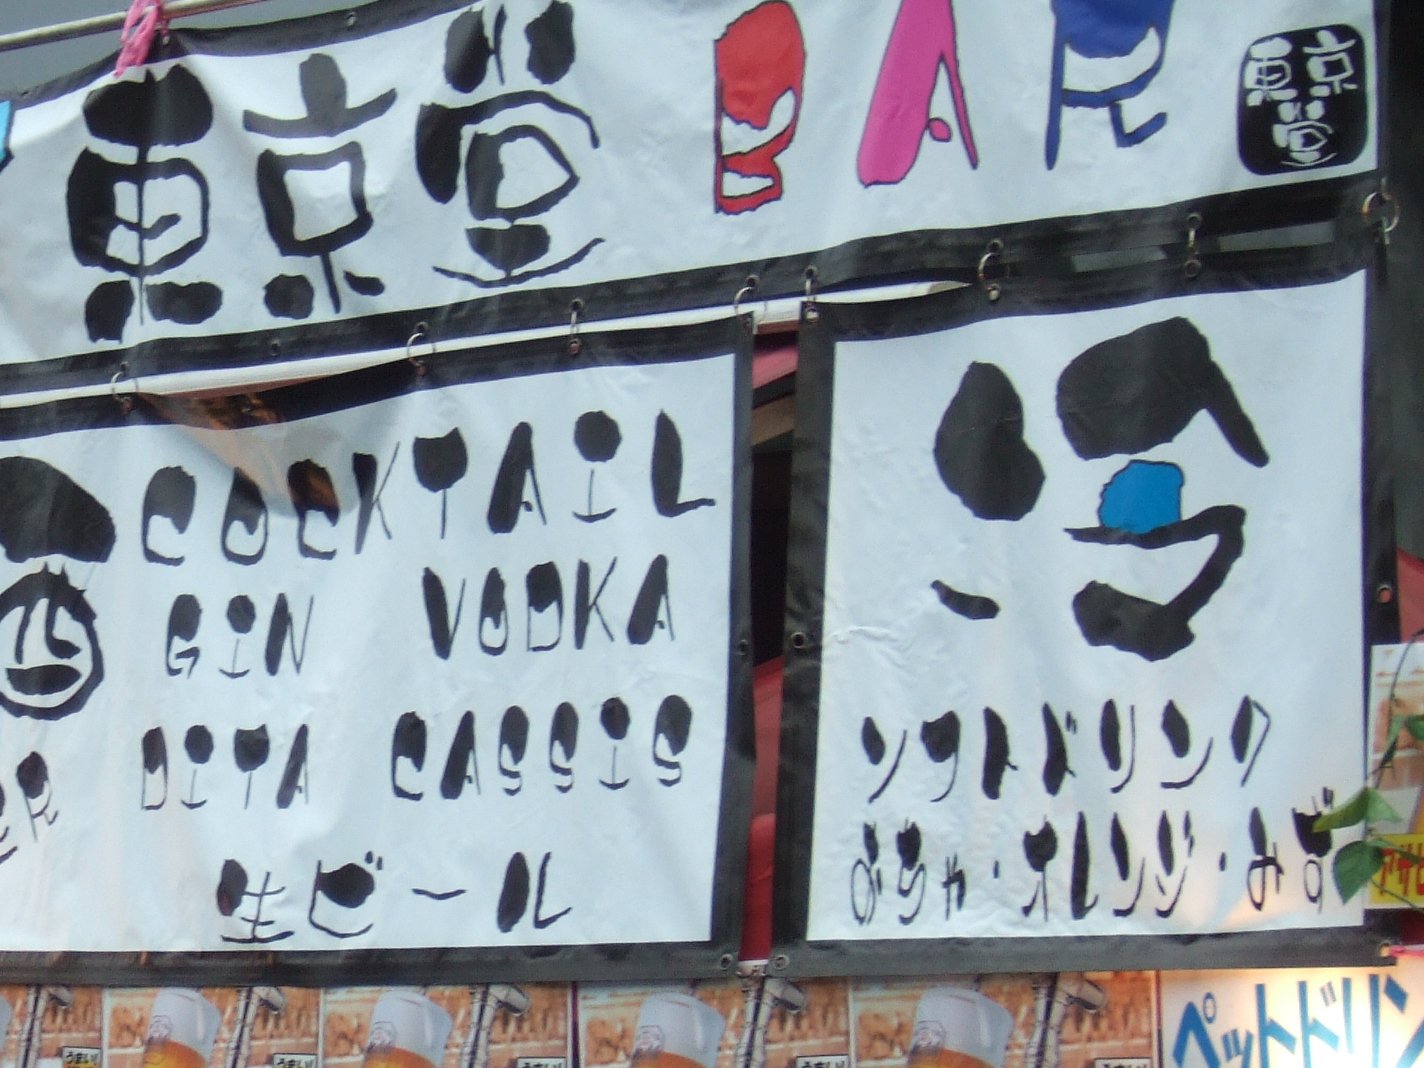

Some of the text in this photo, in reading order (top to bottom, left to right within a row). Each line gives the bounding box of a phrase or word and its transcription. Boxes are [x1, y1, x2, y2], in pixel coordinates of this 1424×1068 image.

[714, 0, 1170, 214] BAR
[141, 407, 715, 566] COCKTAIL
[931, 315, 1270, 663] 冷
[165, 553, 677, 678] GIN VODKA
[141, 693, 692, 810] DITA CASSIS
[862, 694, 1271, 803] ソフトドリンク
[219, 850, 573, 945] 生ビール
